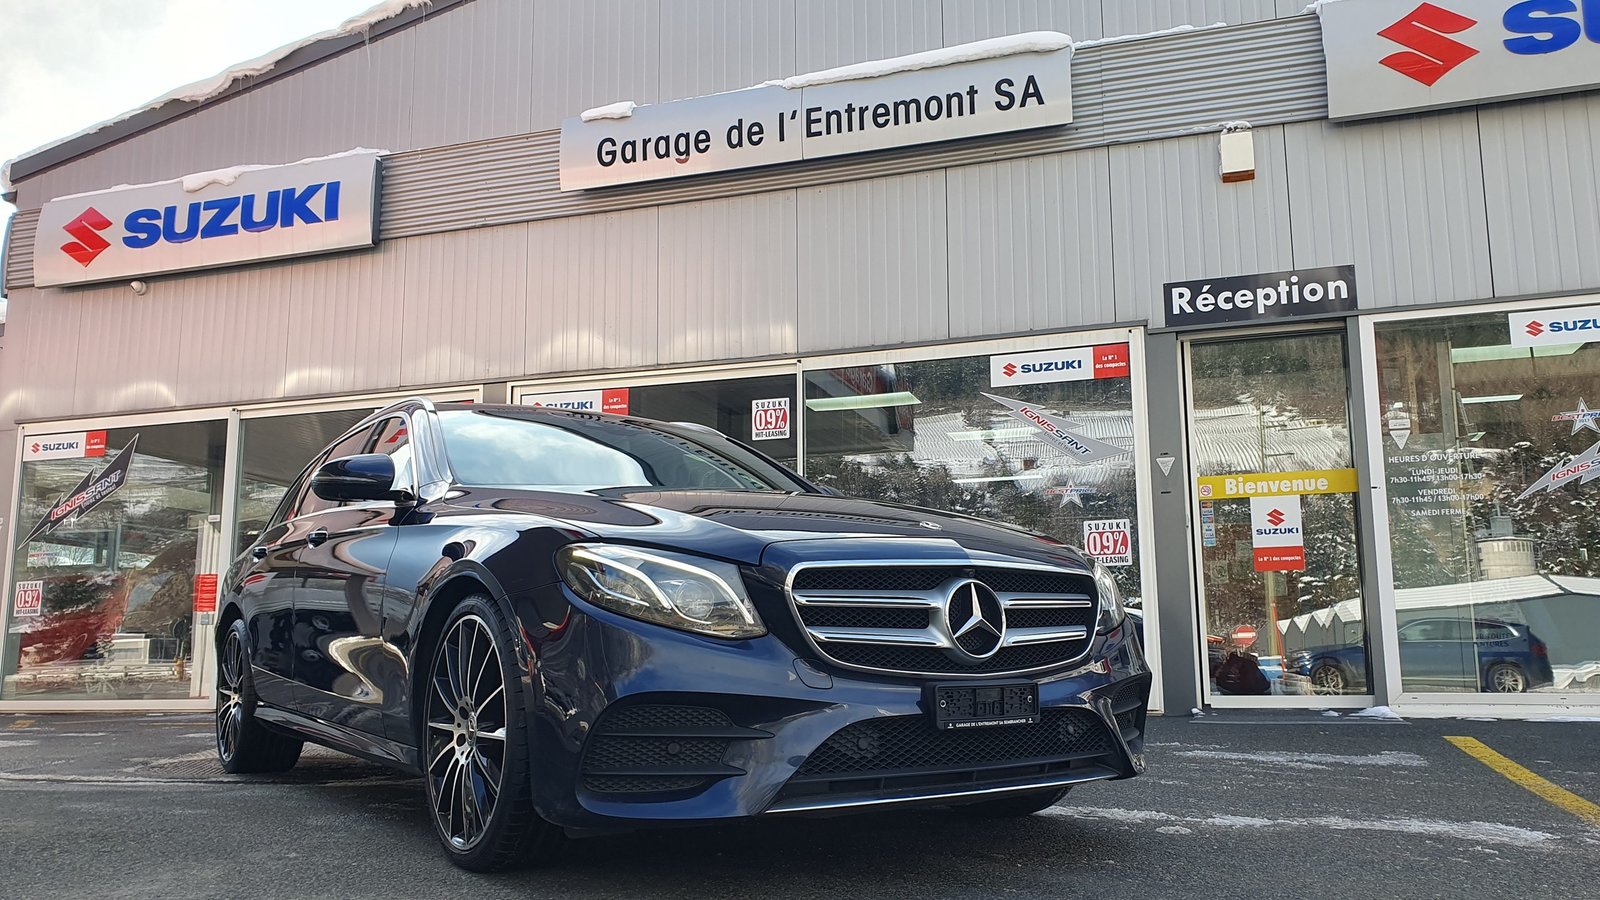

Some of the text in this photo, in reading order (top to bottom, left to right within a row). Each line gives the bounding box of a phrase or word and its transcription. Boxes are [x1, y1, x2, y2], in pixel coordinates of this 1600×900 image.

[596, 74, 1045, 167] Garage de l'Entremont SA
[122, 181, 341, 249] SUZUKI
[1171, 275, 1348, 314] Réception
[1020, 359, 1082, 374] SUZUKI
[1104, 361, 1127, 369] compactes
[755, 400, 787, 409] SUZUKI
[756, 409, 785, 430] 0.9%
[755, 430, 787, 438] HIT-LEASING
[1019, 406, 1092, 455] IGNISSANT
[42, 441, 79, 452] SUZUKI
[1388, 455, 1420, 463] HEURES
[1411, 467, 1458, 476] LUNDI-JEUDI
[1224, 476, 1329, 495] Bienvenue
[50, 469, 121, 521] IGNISSANT
[1417, 487, 1456, 496] VENDREDI
[1391, 496, 1432, 504] 7h30-11h45
[1411, 509, 1440, 517] SAMEDI
[1087, 521, 1127, 531] SUZUKI
[1255, 527, 1299, 536] SUZUKI
[1089, 531, 1126, 555] 0.9%
[1095, 556, 1129, 564] T-LEASING
[18, 582, 41, 590] SUZUKI
[17, 590, 39, 608] 0.9%
